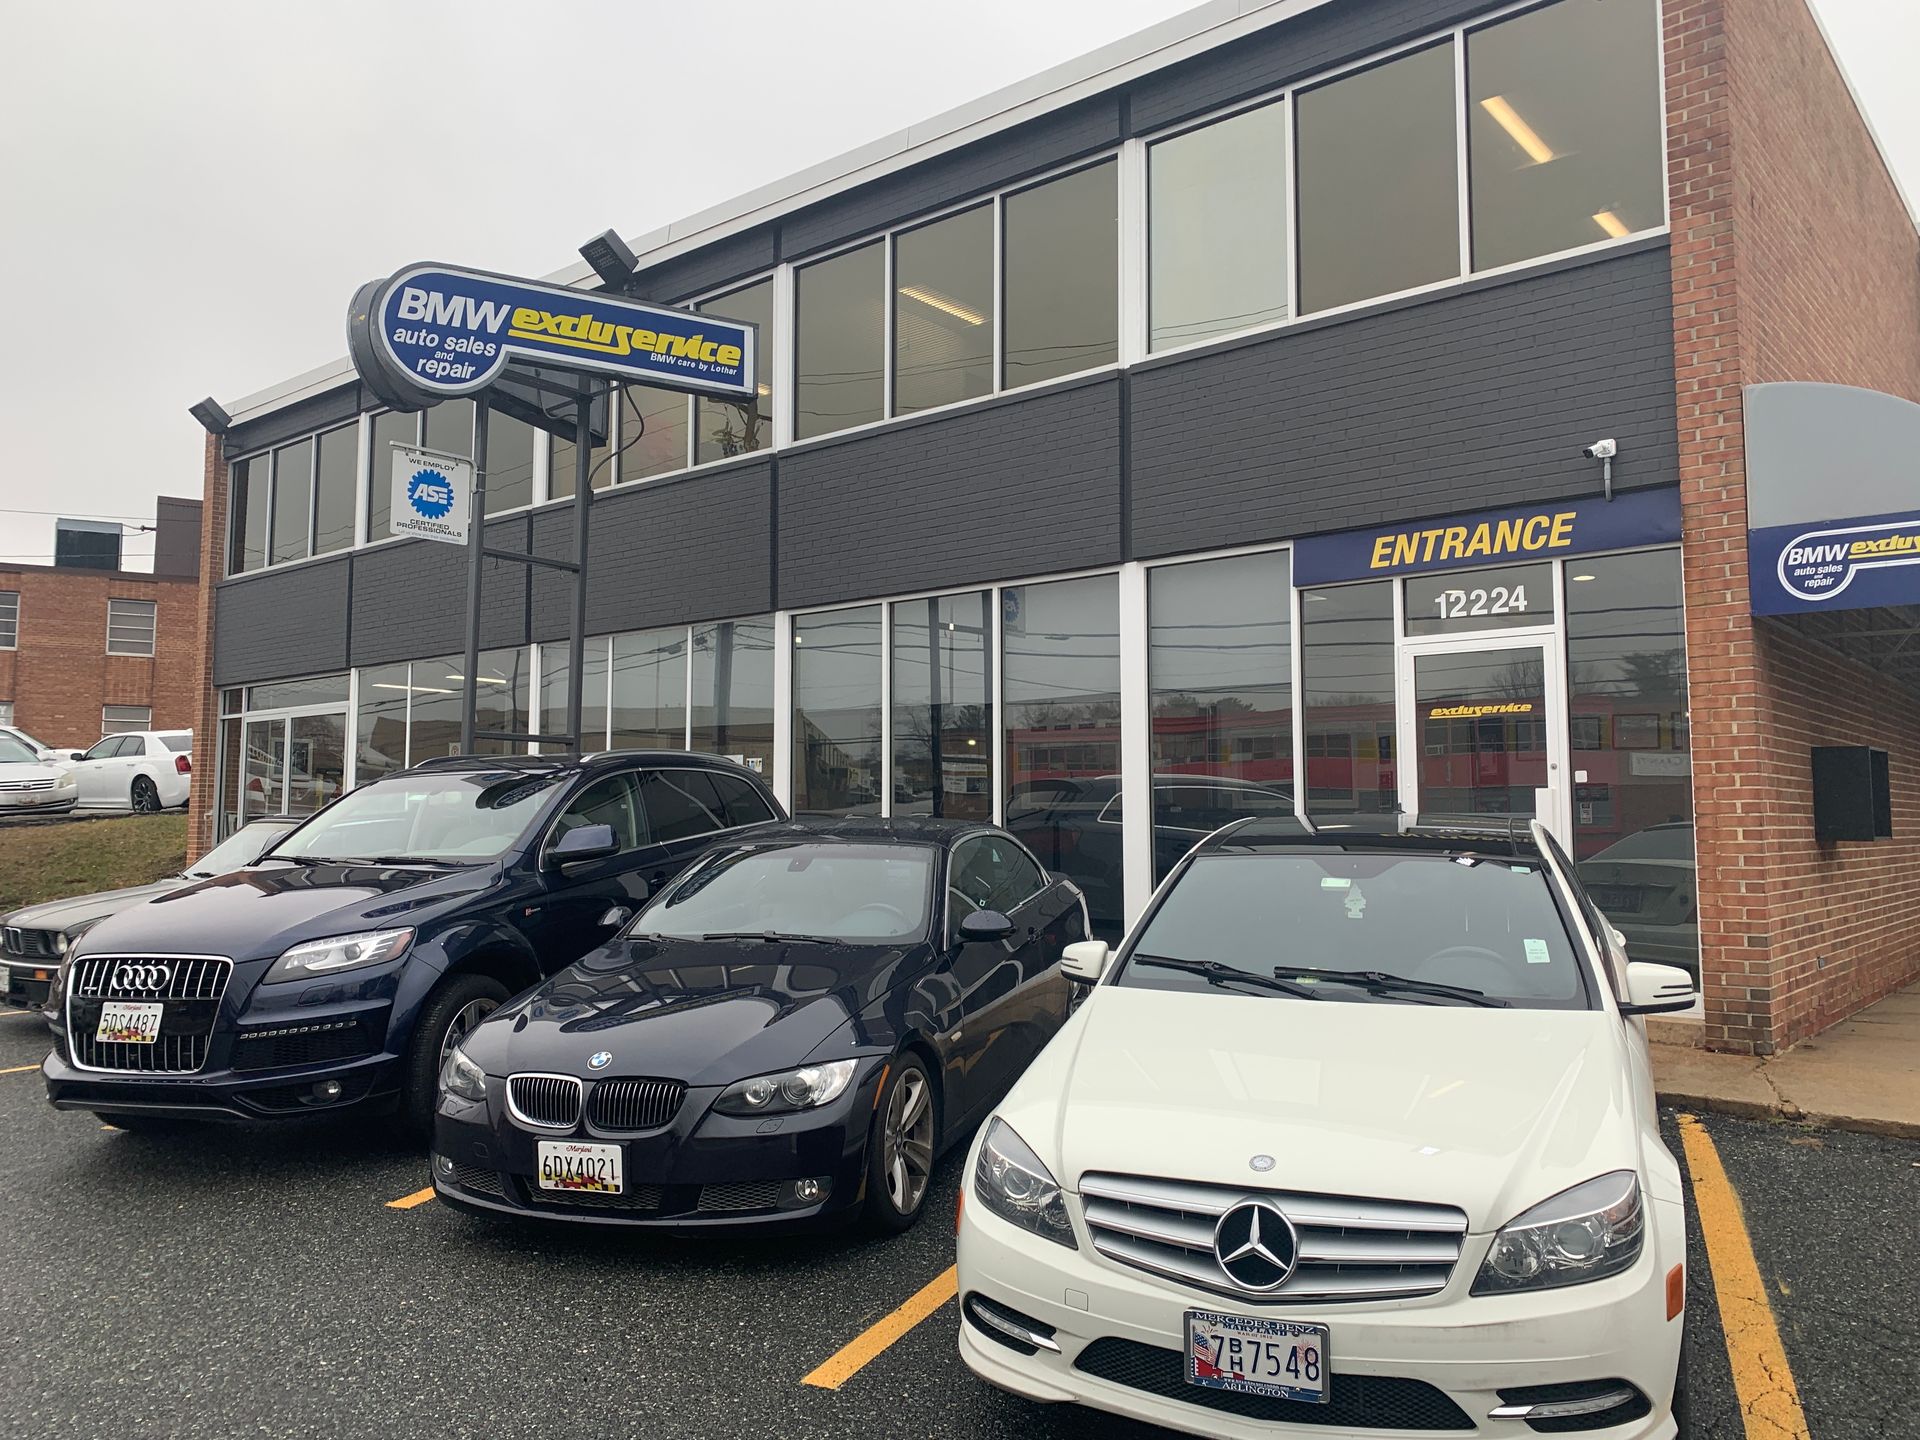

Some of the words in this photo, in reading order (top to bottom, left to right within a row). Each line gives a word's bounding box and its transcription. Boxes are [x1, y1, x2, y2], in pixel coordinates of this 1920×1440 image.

[397, 286, 511, 334] BMW
[393, 327, 439, 348] auto
[444, 335, 497, 357] sales
[434, 351, 454, 361] and
[650, 352, 676, 364] BMW
[677, 359, 696, 368] care
[698, 361, 708, 371] by
[710, 364, 738, 375] Lothar
[416, 358, 476, 379] repair
[409, 457, 422, 465] WE
[423, 461, 455, 471] EMPLOY
[412, 483, 448, 505] ASE
[396, 521, 462, 537] PROFESSIONALS
[410, 519, 450, 530] CERTIFIED
[1370, 511, 1577, 569] ENTRANCE
[1787, 543, 1850, 565] BMW
[1794, 566, 1816, 576] auto
[1817, 564, 1843, 574] sales
[1804, 576, 1835, 588] repair
[1434, 585, 1528, 619] 12224
[101, 1013, 157, 1033] 5DS4487
[566, 1145, 592, 1154] Maryland
[543, 1155, 615, 1181] 6DX4021
[1195, 1312, 1315, 1334] MERCEDES-BENZ
[1222, 1323, 1288, 1337] MARYLAND
[1222, 1382, 1289, 1398] ARLINGTON
